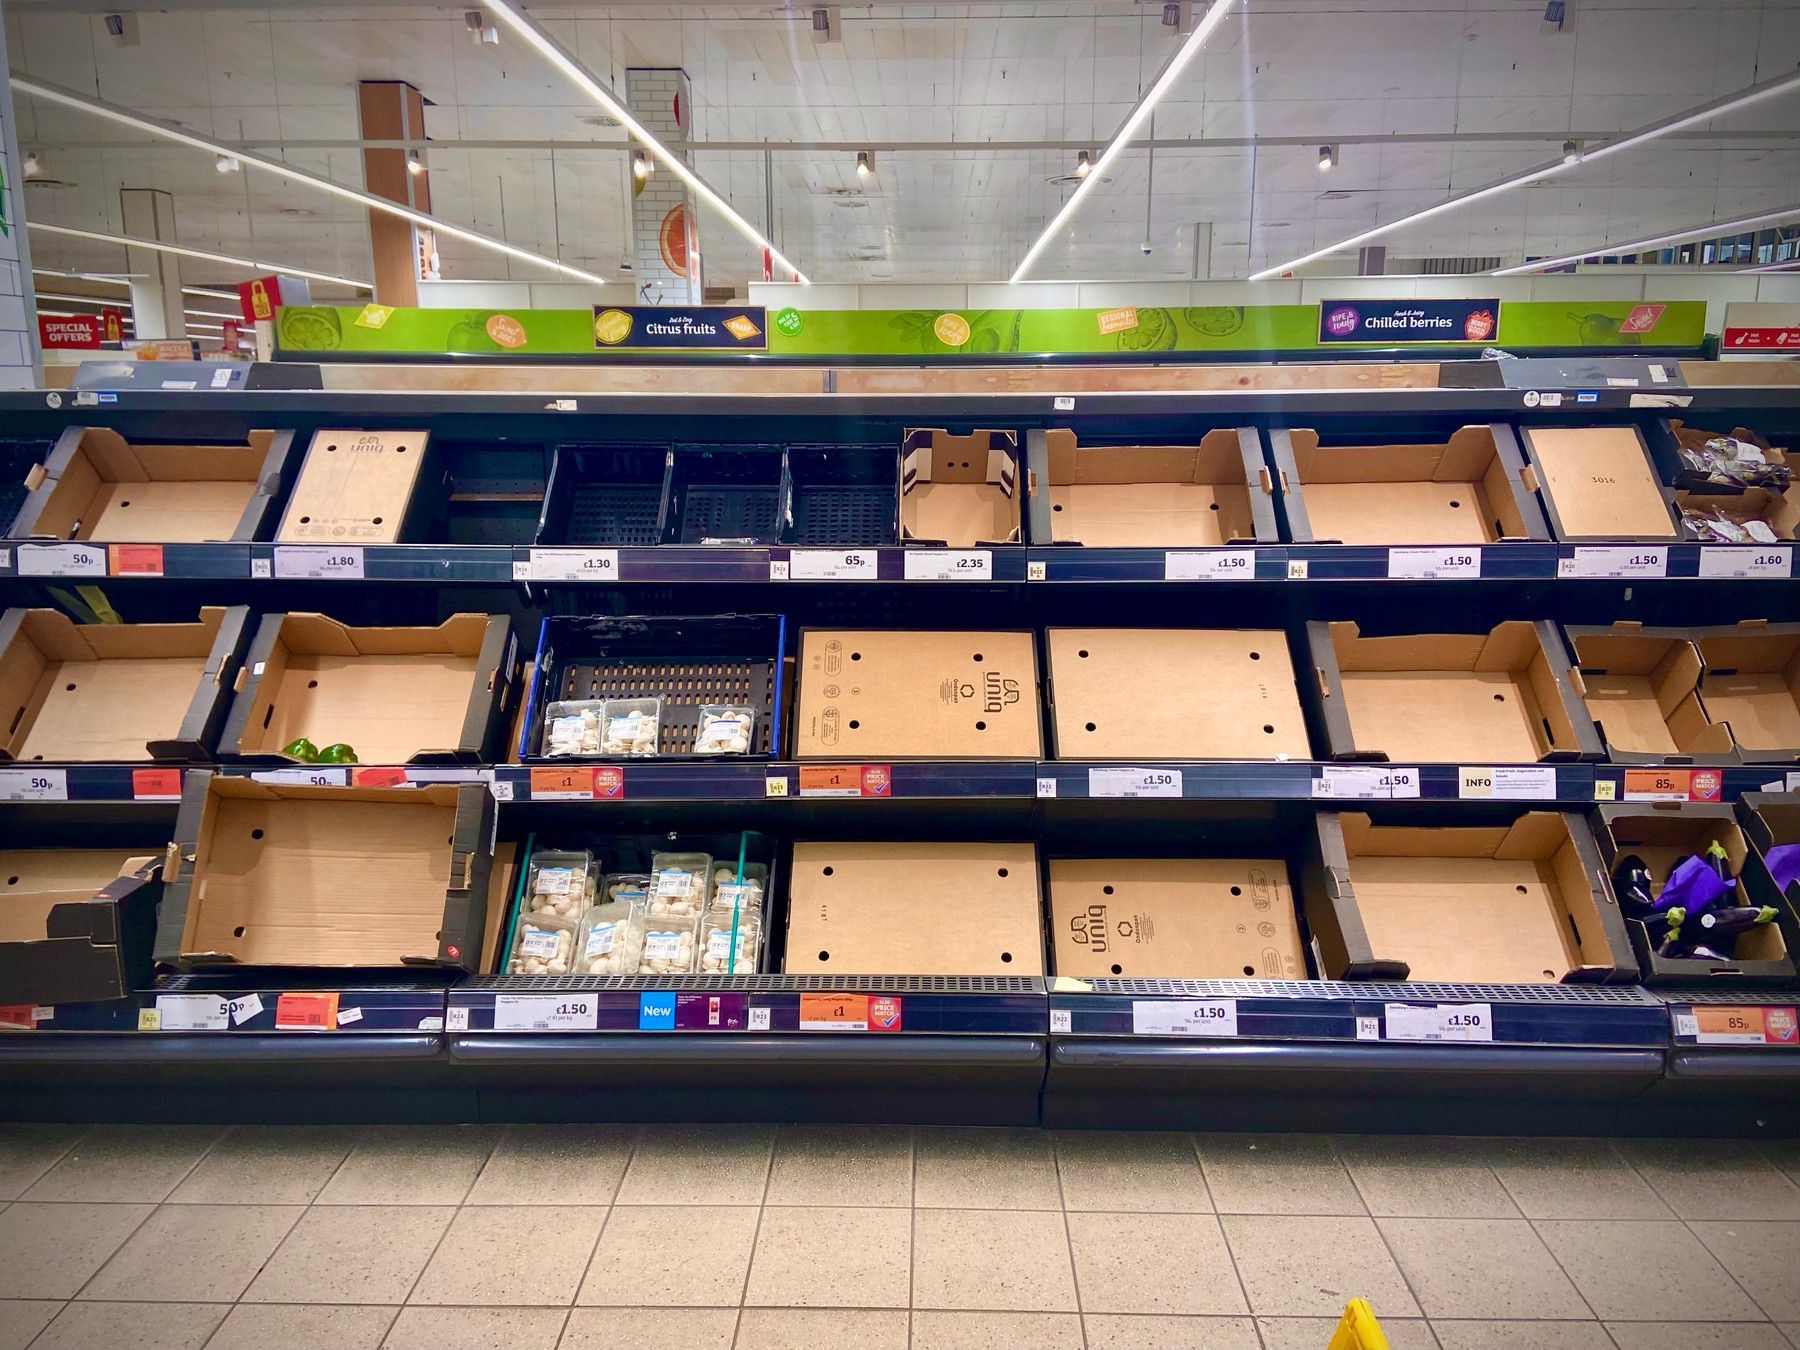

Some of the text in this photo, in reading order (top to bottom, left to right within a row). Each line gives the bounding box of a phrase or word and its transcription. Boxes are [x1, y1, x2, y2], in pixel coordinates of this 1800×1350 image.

[790, 312, 799, 321] 5
[1100, 310, 1135, 323] REGIONAL
[1332, 313, 1347, 322] RIPE
[45, 323, 93, 333] SPECIAL
[942, 317, 959, 330] RIPE
[1333, 316, 1356, 331] ready
[1365, 316, 1453, 329] Chilled berries
[1470, 319, 1487, 328] BERRY
[646, 323, 681, 335] Citrus
[683, 323, 716, 335] fruits
[1467, 325, 1486, 335] GOOD
[49, 332, 92, 342] OFFERS
[351, 444, 384, 454] uniq
[1591, 476, 1616, 484] 3016
[73, 554, 94, 565] 50p
[327, 556, 354, 566] £1.80
[583, 559, 611, 569] £1.30
[845, 556, 865, 567] 65p
[956, 558, 983, 568] £2.35
[1218, 558, 1246, 568] £1.50
[1444, 556, 1472, 566] £1.50
[1629, 555, 1658, 565] £1.50
[1754, 555, 1782, 565] £1.60
[984, 671, 1002, 713] uniq
[31, 778, 53, 789] 50p
[562, 776, 572, 787] £1
[830, 774, 840, 785] £1
[1143, 775, 1172, 785] £1.50
[1379, 775, 1409, 786] £1.50
[1465, 778, 1492, 787] INFO
[1655, 779, 1675, 790] 85p
[1088, 904, 1107, 953] uniq
[219, 1001, 245, 1015] 50p
[556, 1003, 587, 1015] £1.50
[643, 1005, 672, 1017] New
[833, 1006, 845, 1017] £1
[1193, 1007, 1226, 1019] £1.50
[1448, 1015, 1481, 1026] £1.50
[1728, 1017, 1750, 1030] 85p
